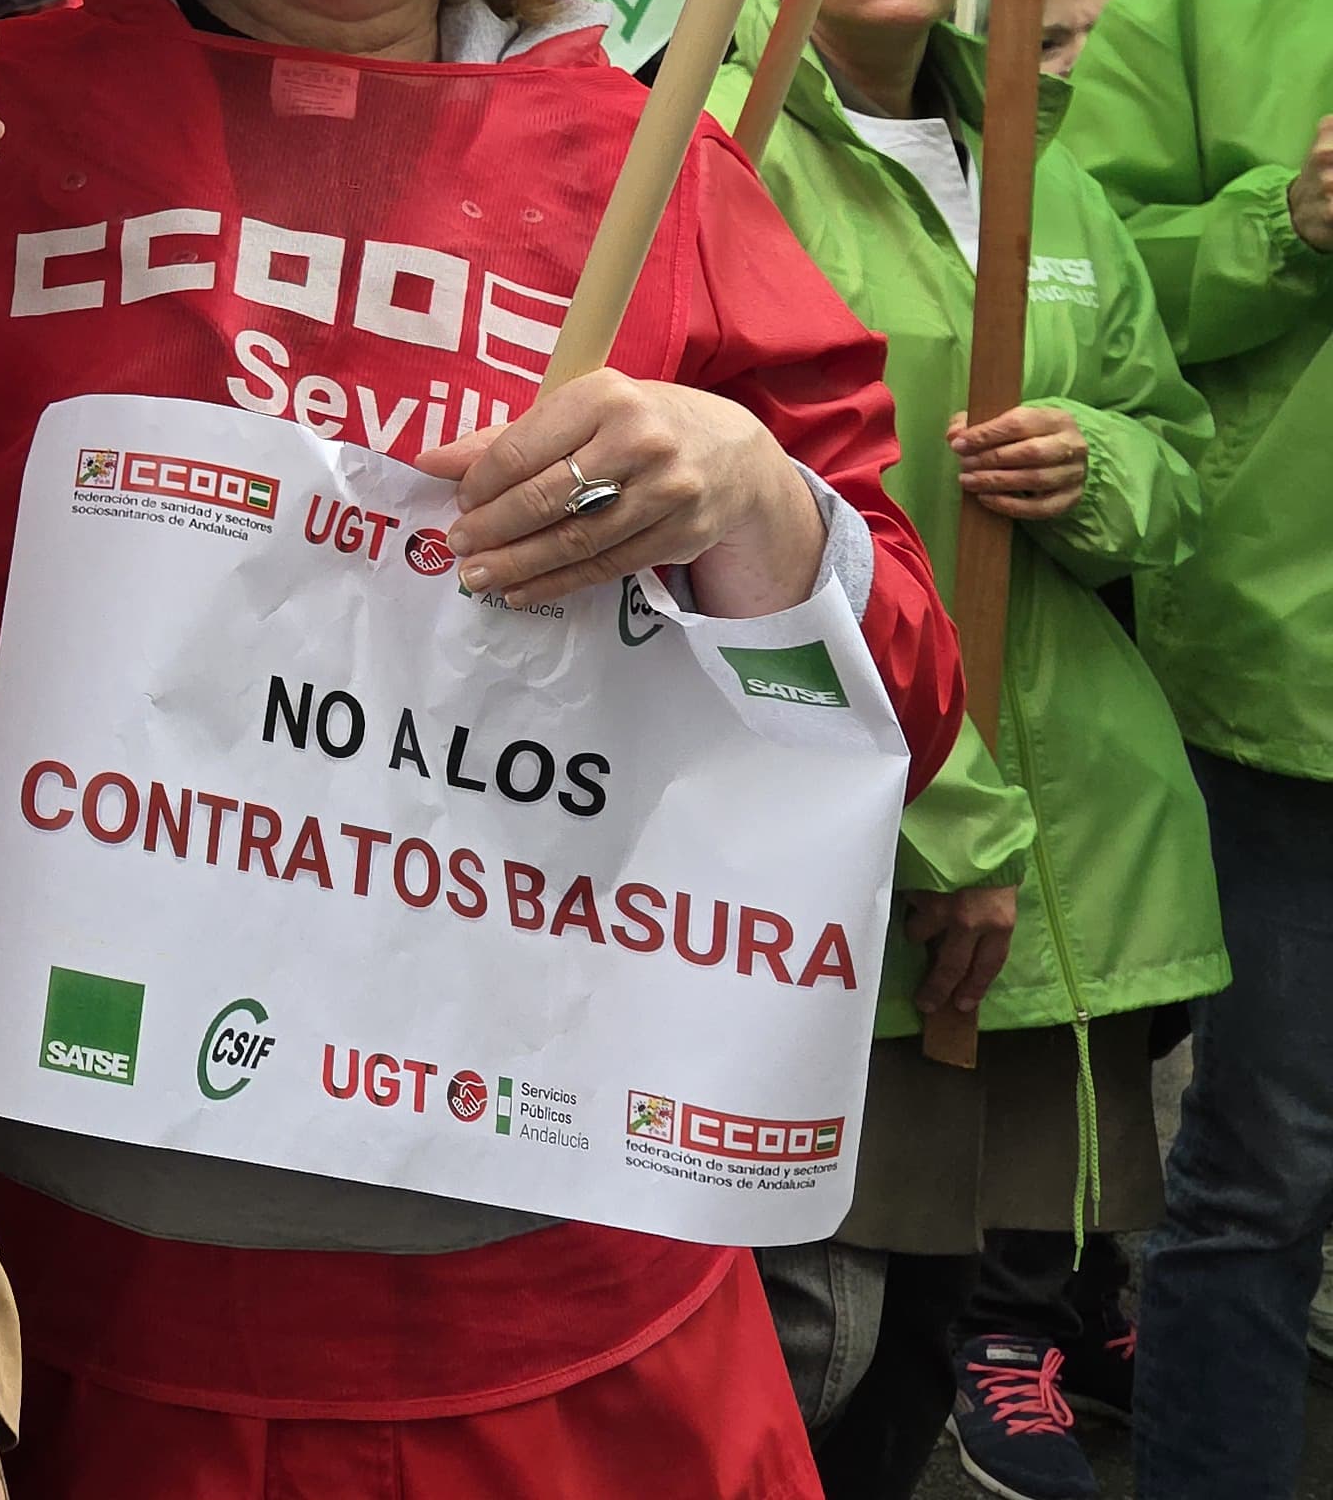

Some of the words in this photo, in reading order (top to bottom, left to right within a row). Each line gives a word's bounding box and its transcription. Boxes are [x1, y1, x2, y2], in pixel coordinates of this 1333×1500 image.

[10, 209, 470, 352] CCOO
[130, 460, 247, 504] CCOO
[71, 503, 165, 525] sociosanitarios
[167, 513, 185, 527] de
[188, 517, 250, 542] Andalucía
[73, 490, 139, 508] federación
[141, 495, 158, 509] de
[160, 499, 213, 519] sanidad
[214, 511, 224, 524] y
[224, 512, 273, 535] sectores
[303, 494, 401, 562] UGT
[747, 679, 842, 706] SATSE
[261, 675, 365, 759] NO
[388, 707, 431, 780] A
[445, 726, 611, 817] LOS
[19, 760, 491, 920] CONTRATOS
[505, 859, 858, 991] BASURA
[46, 1040, 130, 1079] SATSE
[212, 1028, 276, 1070] CSIF
[322, 1043, 438, 1113] UGT
[520, 1082, 578, 1106] Servicios
[520, 1102, 573, 1125] Públicos
[689, 1112, 814, 1155] CCOO
[519, 1123, 590, 1151] Andalucía
[625, 1138, 702, 1168] federación
[706, 1158, 724, 1173] de
[727, 1161, 781, 1178] sanidad
[782, 1166, 791, 1180] y
[793, 1162, 839, 1177] sectores
[625, 1155, 733, 1189] sociosanitarios
[736, 1175, 754, 1190] de
[756, 1174, 816, 1191] Andalucía
